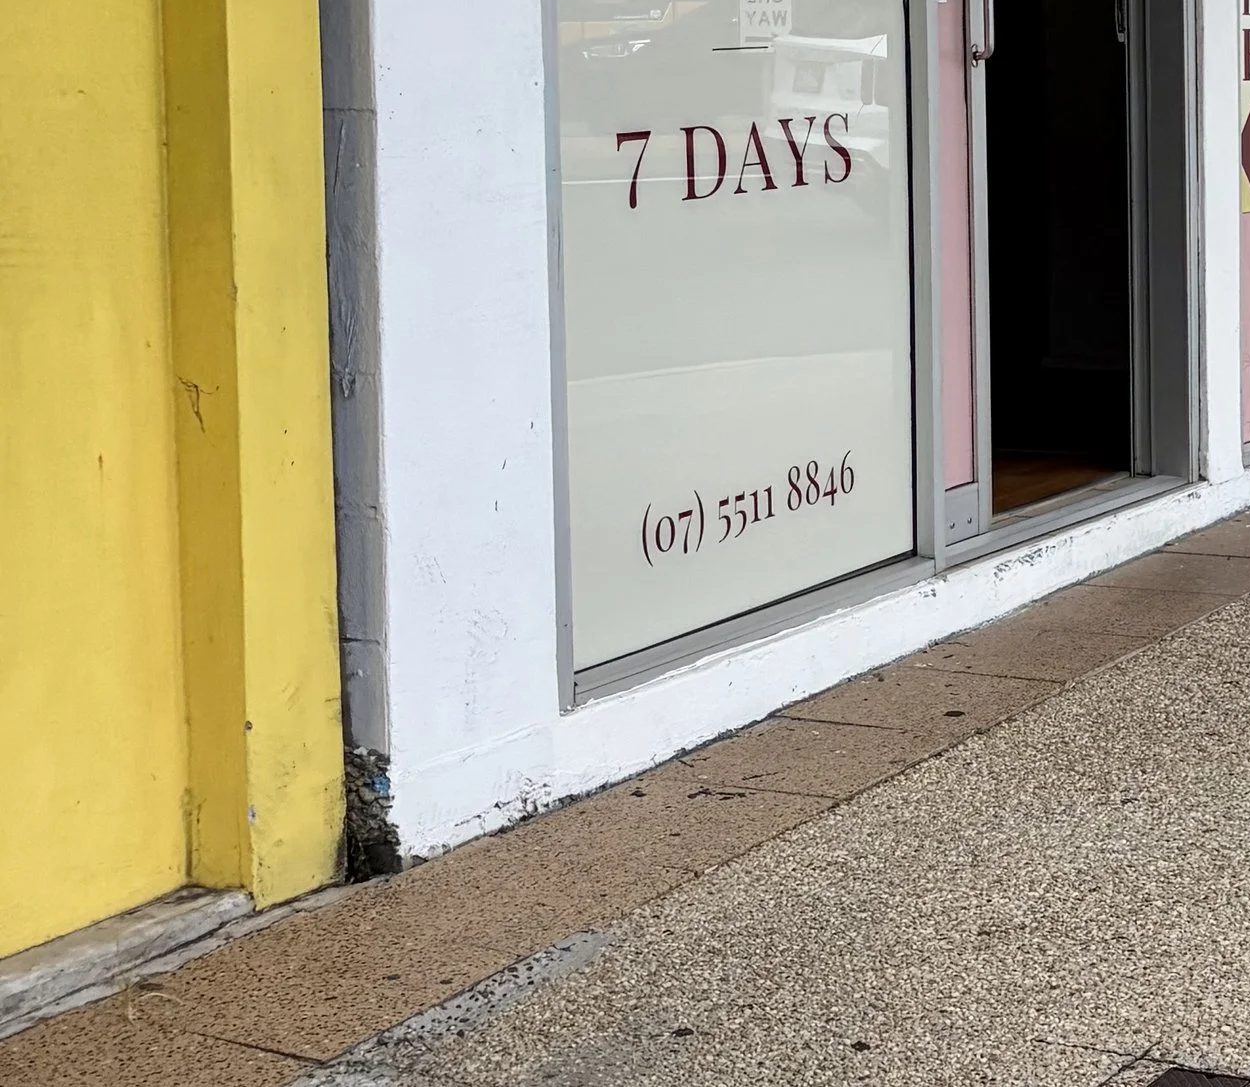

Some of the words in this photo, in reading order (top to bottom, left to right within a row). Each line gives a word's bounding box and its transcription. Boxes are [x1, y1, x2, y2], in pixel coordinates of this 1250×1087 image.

[616, 130, 651, 209] 7
[680, 113, 852, 201] DAYS
[642, 490, 705, 567] (07)
[718, 485, 775, 543] 5511
[787, 449, 855, 512] 8846
